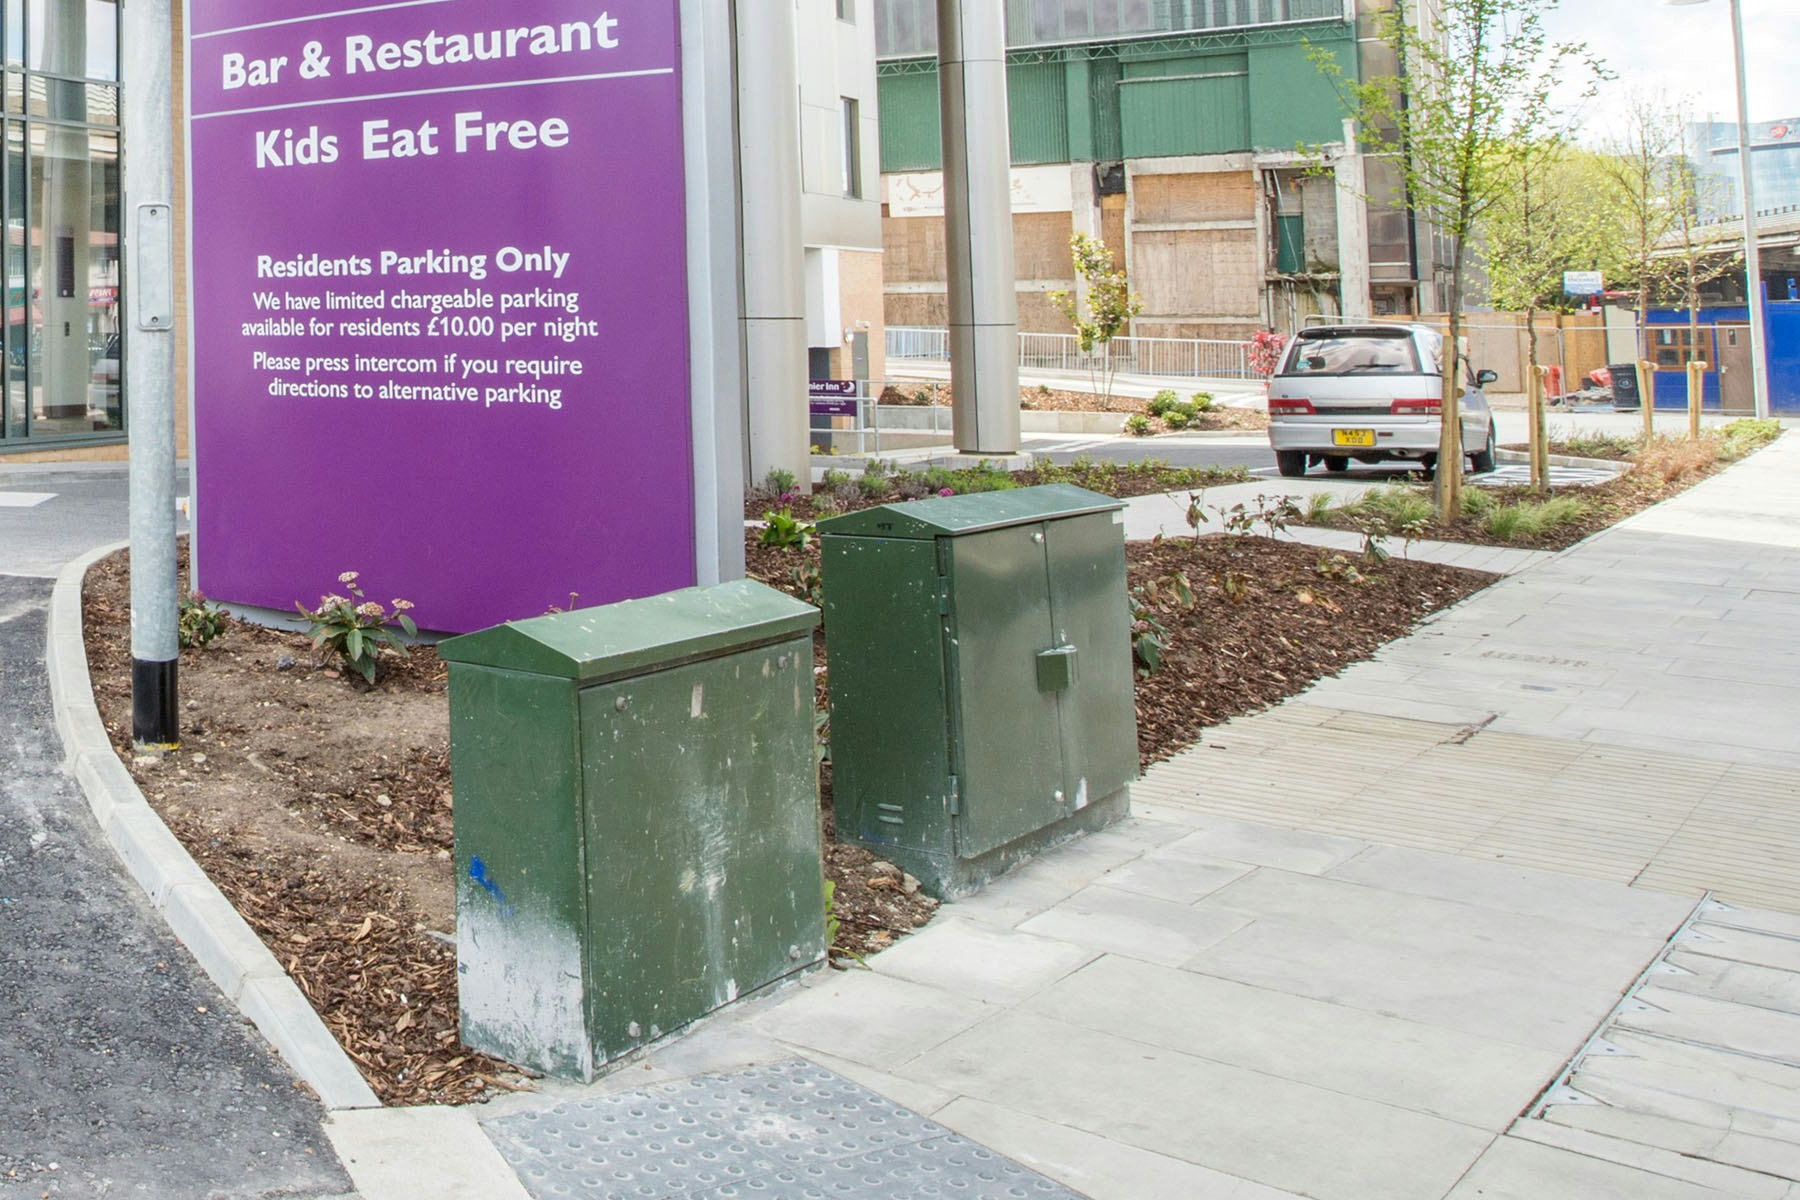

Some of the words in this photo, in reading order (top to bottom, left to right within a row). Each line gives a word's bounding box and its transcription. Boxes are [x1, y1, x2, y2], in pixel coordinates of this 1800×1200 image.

[222, 52, 288, 90] Bar
[299, 41, 331, 79] &
[345, 11, 619, 74] Restaurant
[255, 125, 339, 169] Kids
[362, 119, 439, 160] Eat
[454, 111, 570, 154] Free
[257, 253, 372, 279] Residents
[380, 249, 487, 280] Parking
[495, 246, 571, 278] Only
[252, 292, 281, 311] We
[284, 292, 321, 310] have
[325, 290, 385, 310] limited
[390, 288, 494, 315] chargeable
[500, 288, 580, 314] parking
[241, 318, 305, 337] available
[309, 317, 335, 336] for
[339, 317, 421, 337] residents
[426, 315, 495, 337] £10.00
[500, 320, 537, 343] per
[543, 316, 599, 343] night
[253, 351, 301, 372] Please
[305, 357, 350, 379] press
[354, 353, 437, 374] intercom
[443, 353, 458, 373] if
[461, 359, 498, 380] you
[505, 356, 583, 381] require
[268, 377, 349, 398] directions
[353, 381, 374, 398] to
[378, 380, 479, 402] alternative
[485, 383, 563, 410] parking
[825, 382, 840, 391] Inn
